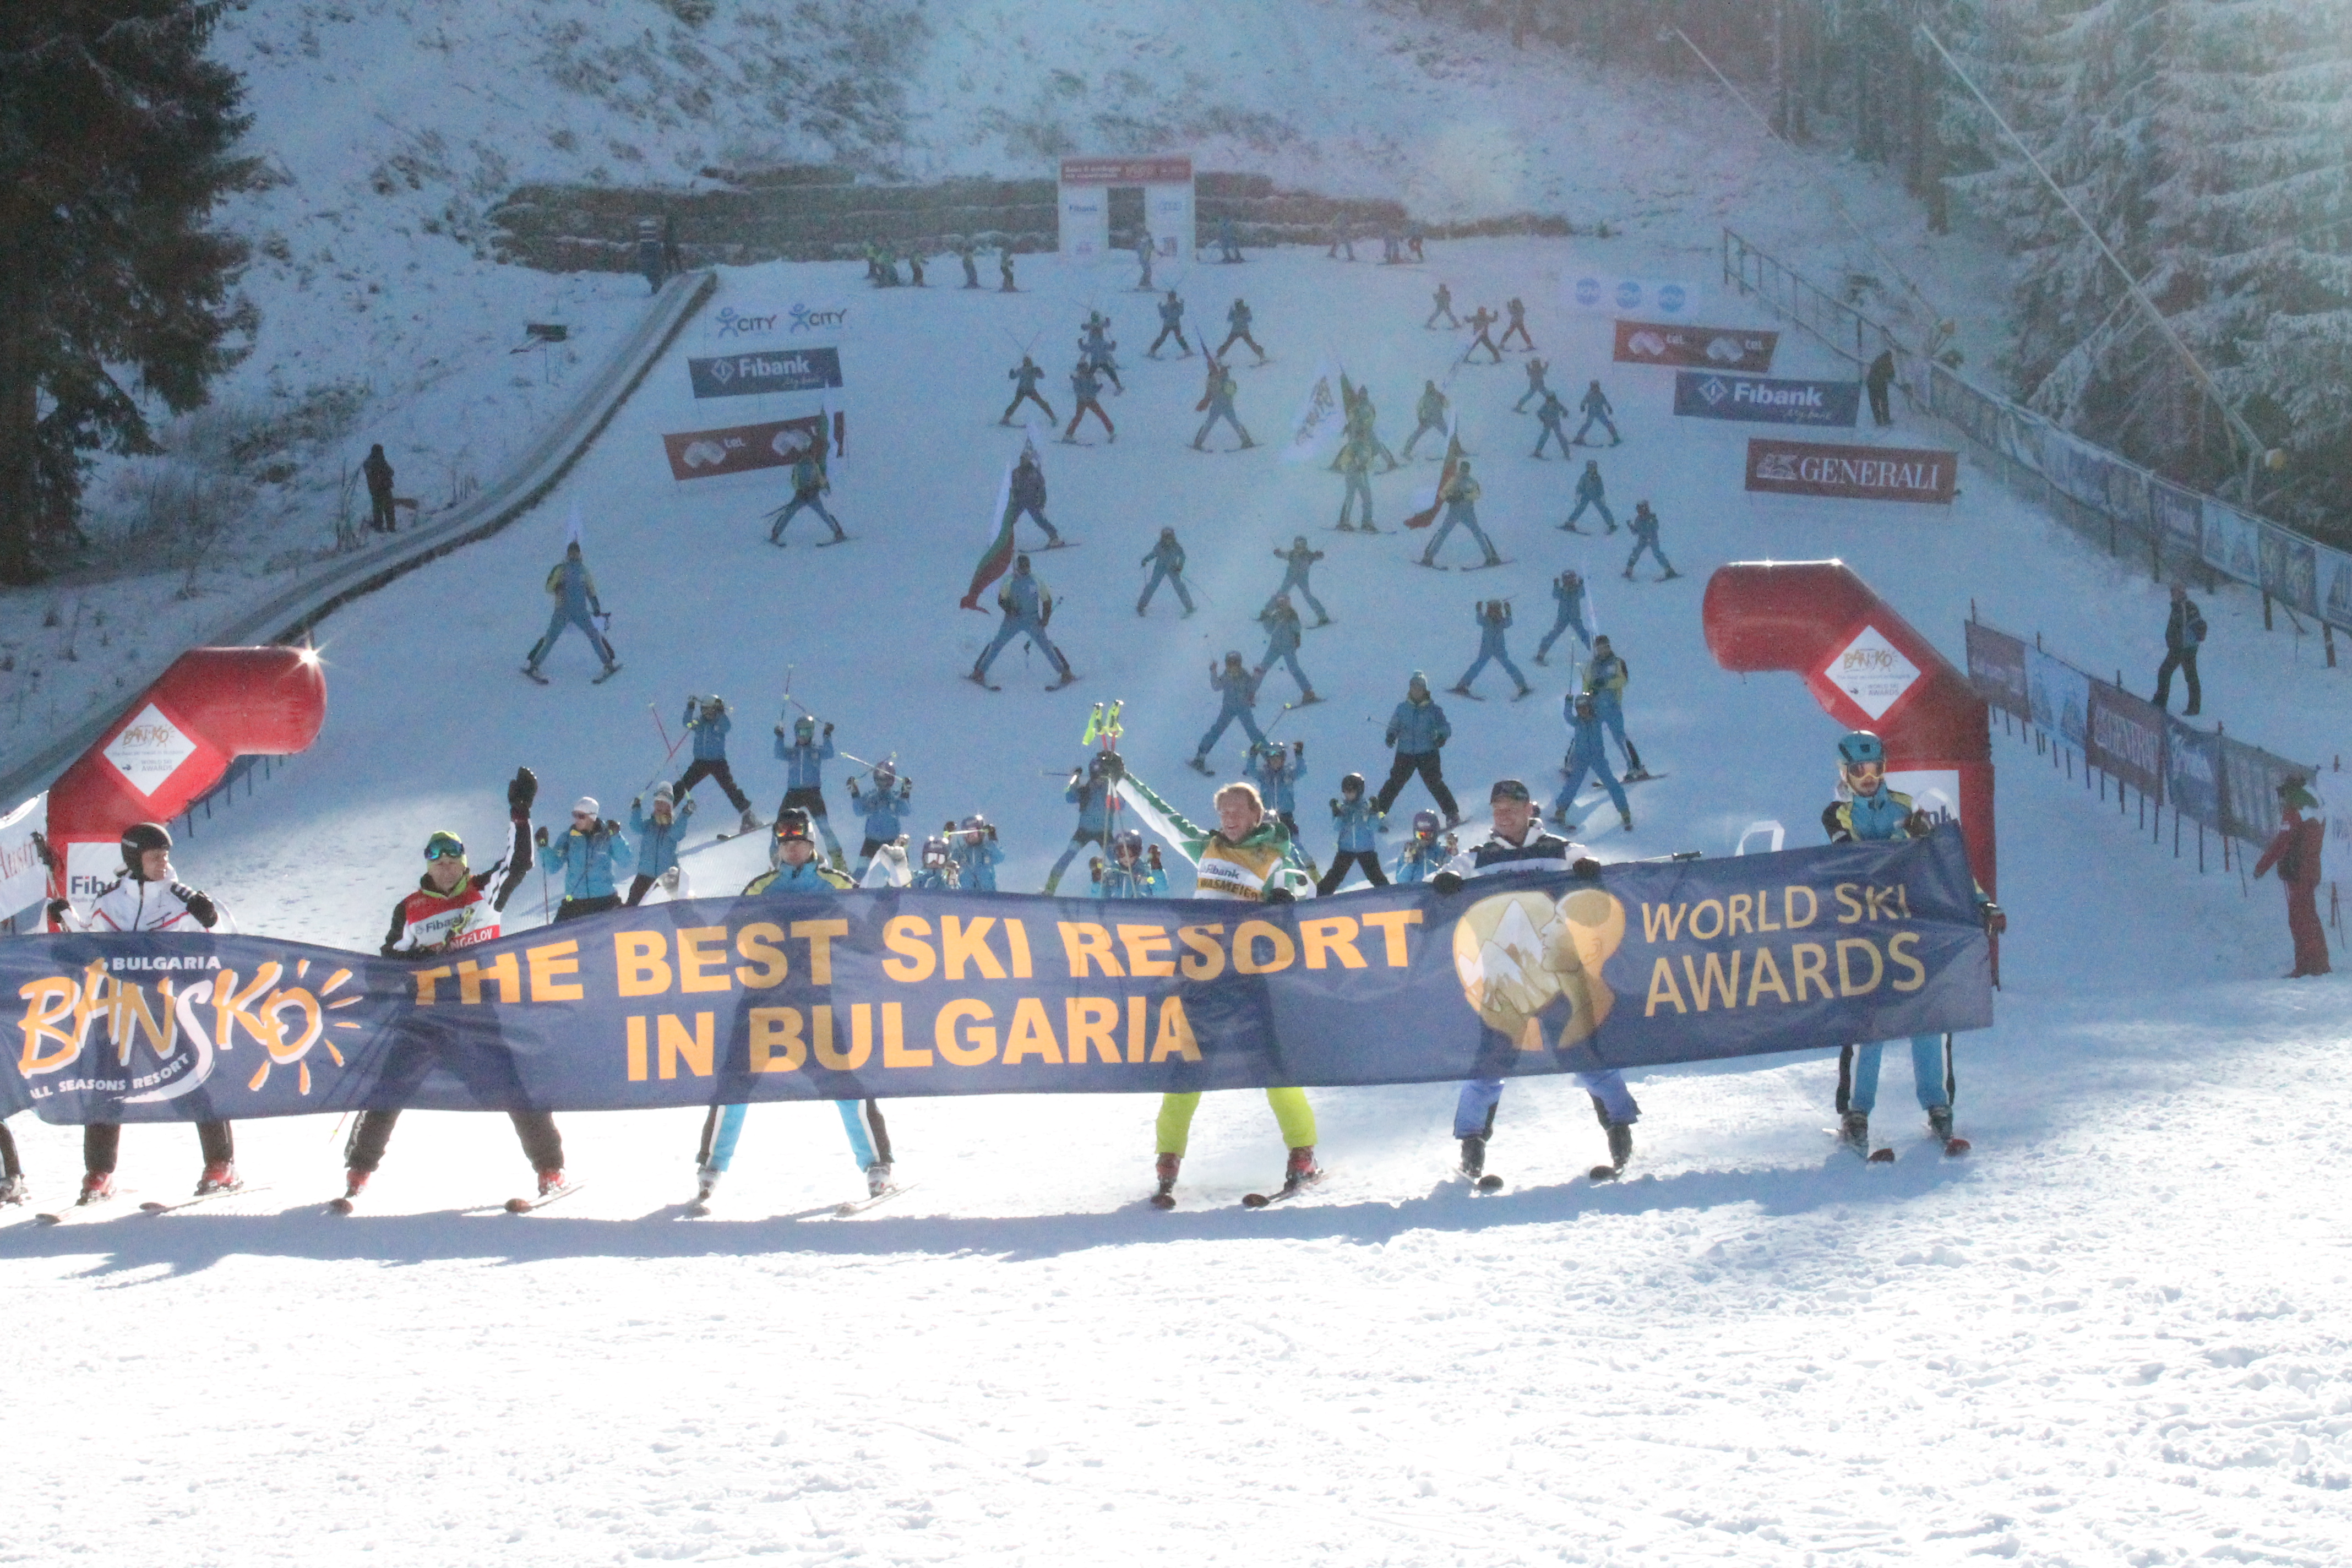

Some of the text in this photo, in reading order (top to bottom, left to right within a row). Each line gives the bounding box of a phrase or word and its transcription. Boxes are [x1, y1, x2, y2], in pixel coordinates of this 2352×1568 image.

[737, 314, 777, 331] CITY
[809, 308, 847, 326] CITY
[739, 355, 810, 378] Fibank
[1734, 383, 1823, 407] Fibank
[1800, 456, 1941, 491] GENERALI
[426, 913, 463, 933] Fiba
[1642, 883, 1912, 944] WORLD SKI
[112, 955, 222, 971] BULGARIA
[409, 909, 1423, 1005] THE BEST SKI RESORT
[1643, 931, 1926, 1017] AWARDS
[18, 957, 323, 1103] BANSKO
[625, 995, 1203, 1081] IN BULGARIA
[58, 1079, 127, 1092] SEASONS
[132, 1053, 189, 1089] RESORT
